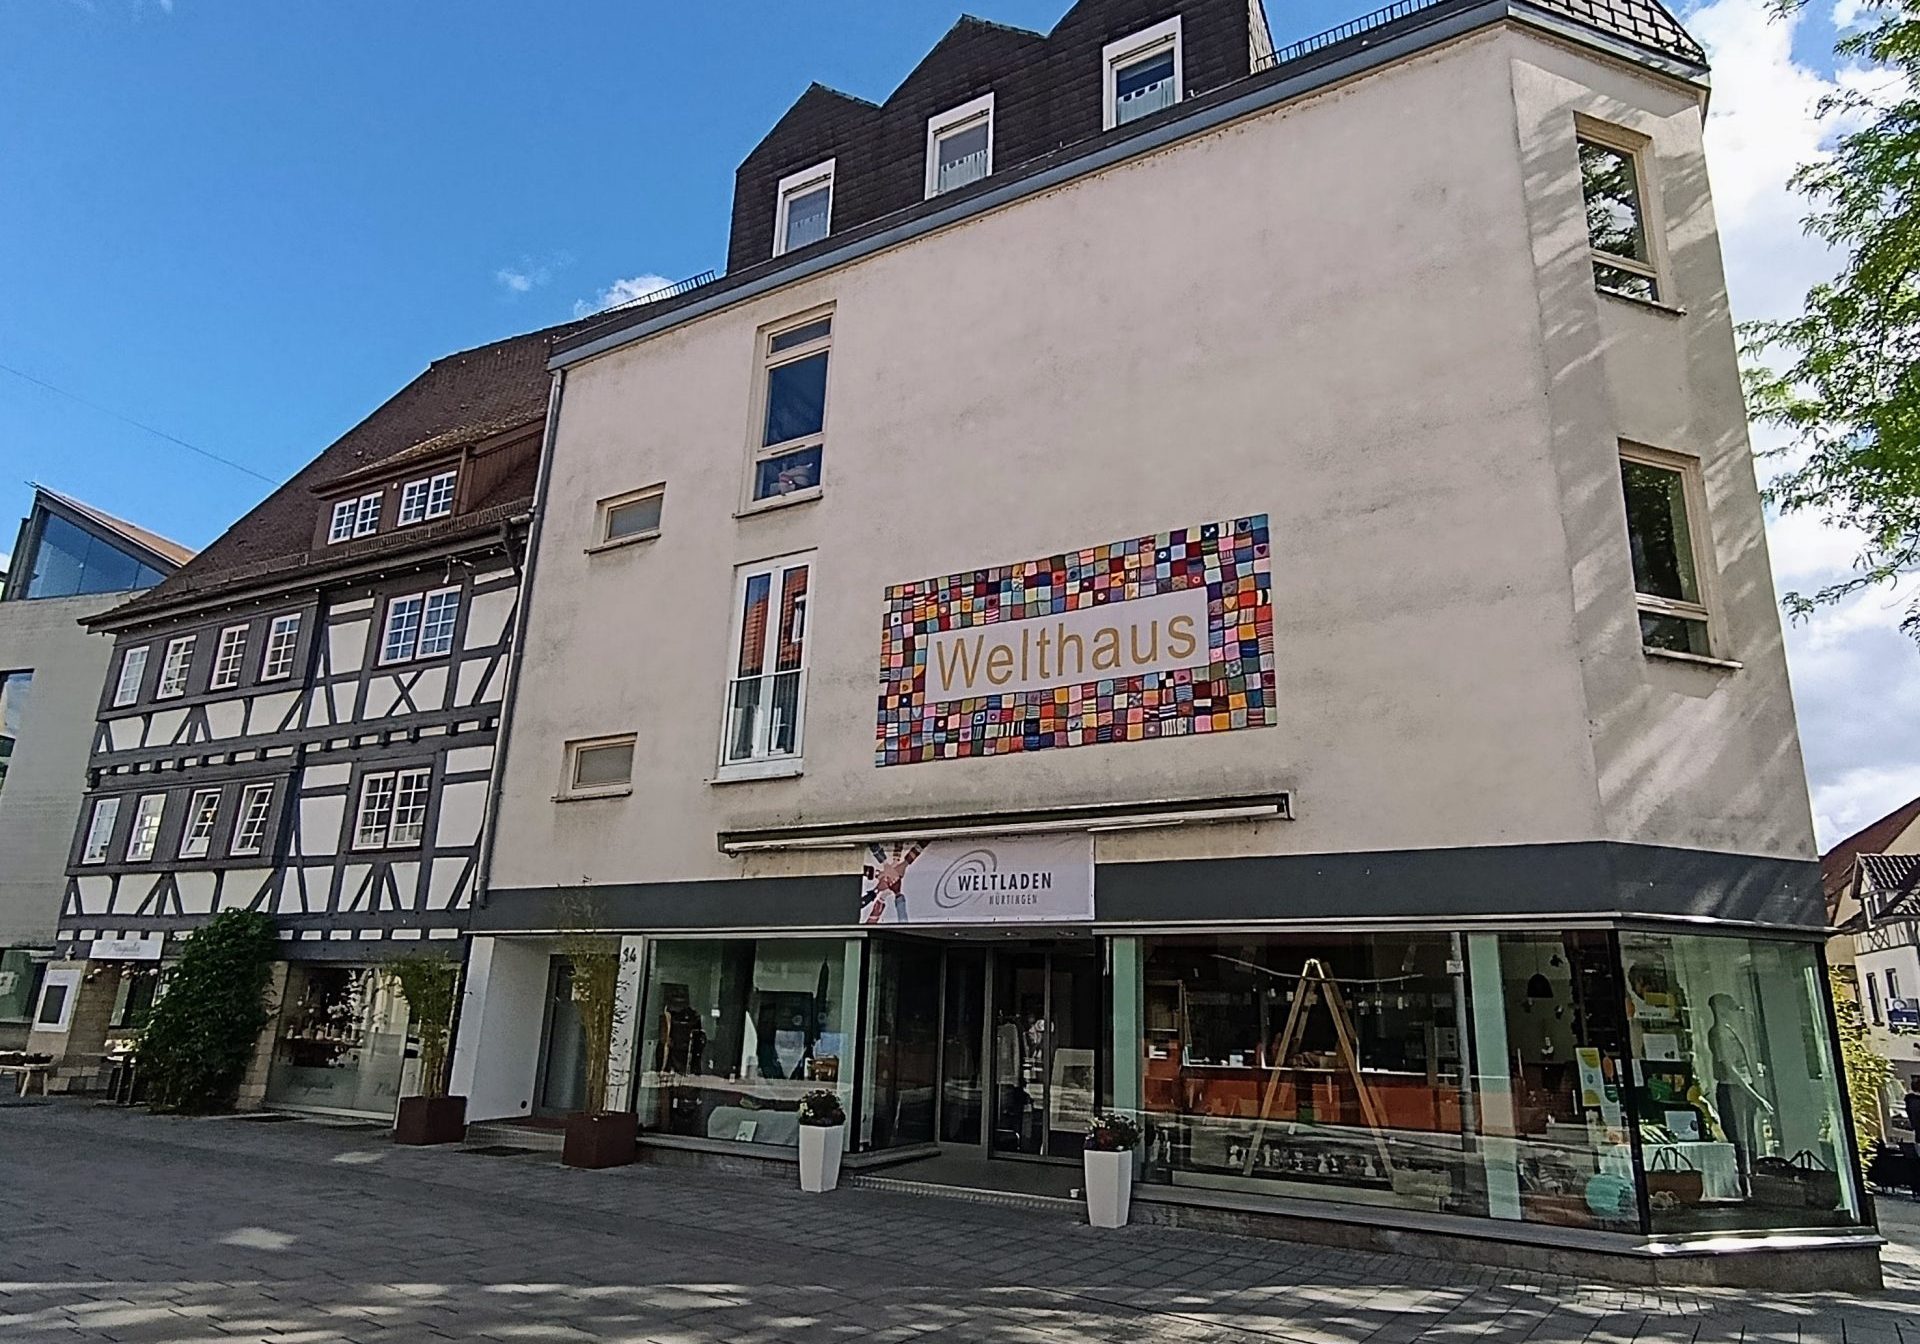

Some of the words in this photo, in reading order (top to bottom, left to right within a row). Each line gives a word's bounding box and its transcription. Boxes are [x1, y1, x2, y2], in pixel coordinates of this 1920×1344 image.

[936, 614, 1197, 692] Welthaus
[958, 872, 1052, 891] WELTLADEN
[989, 893, 1038, 905] NÜRTINGEN
